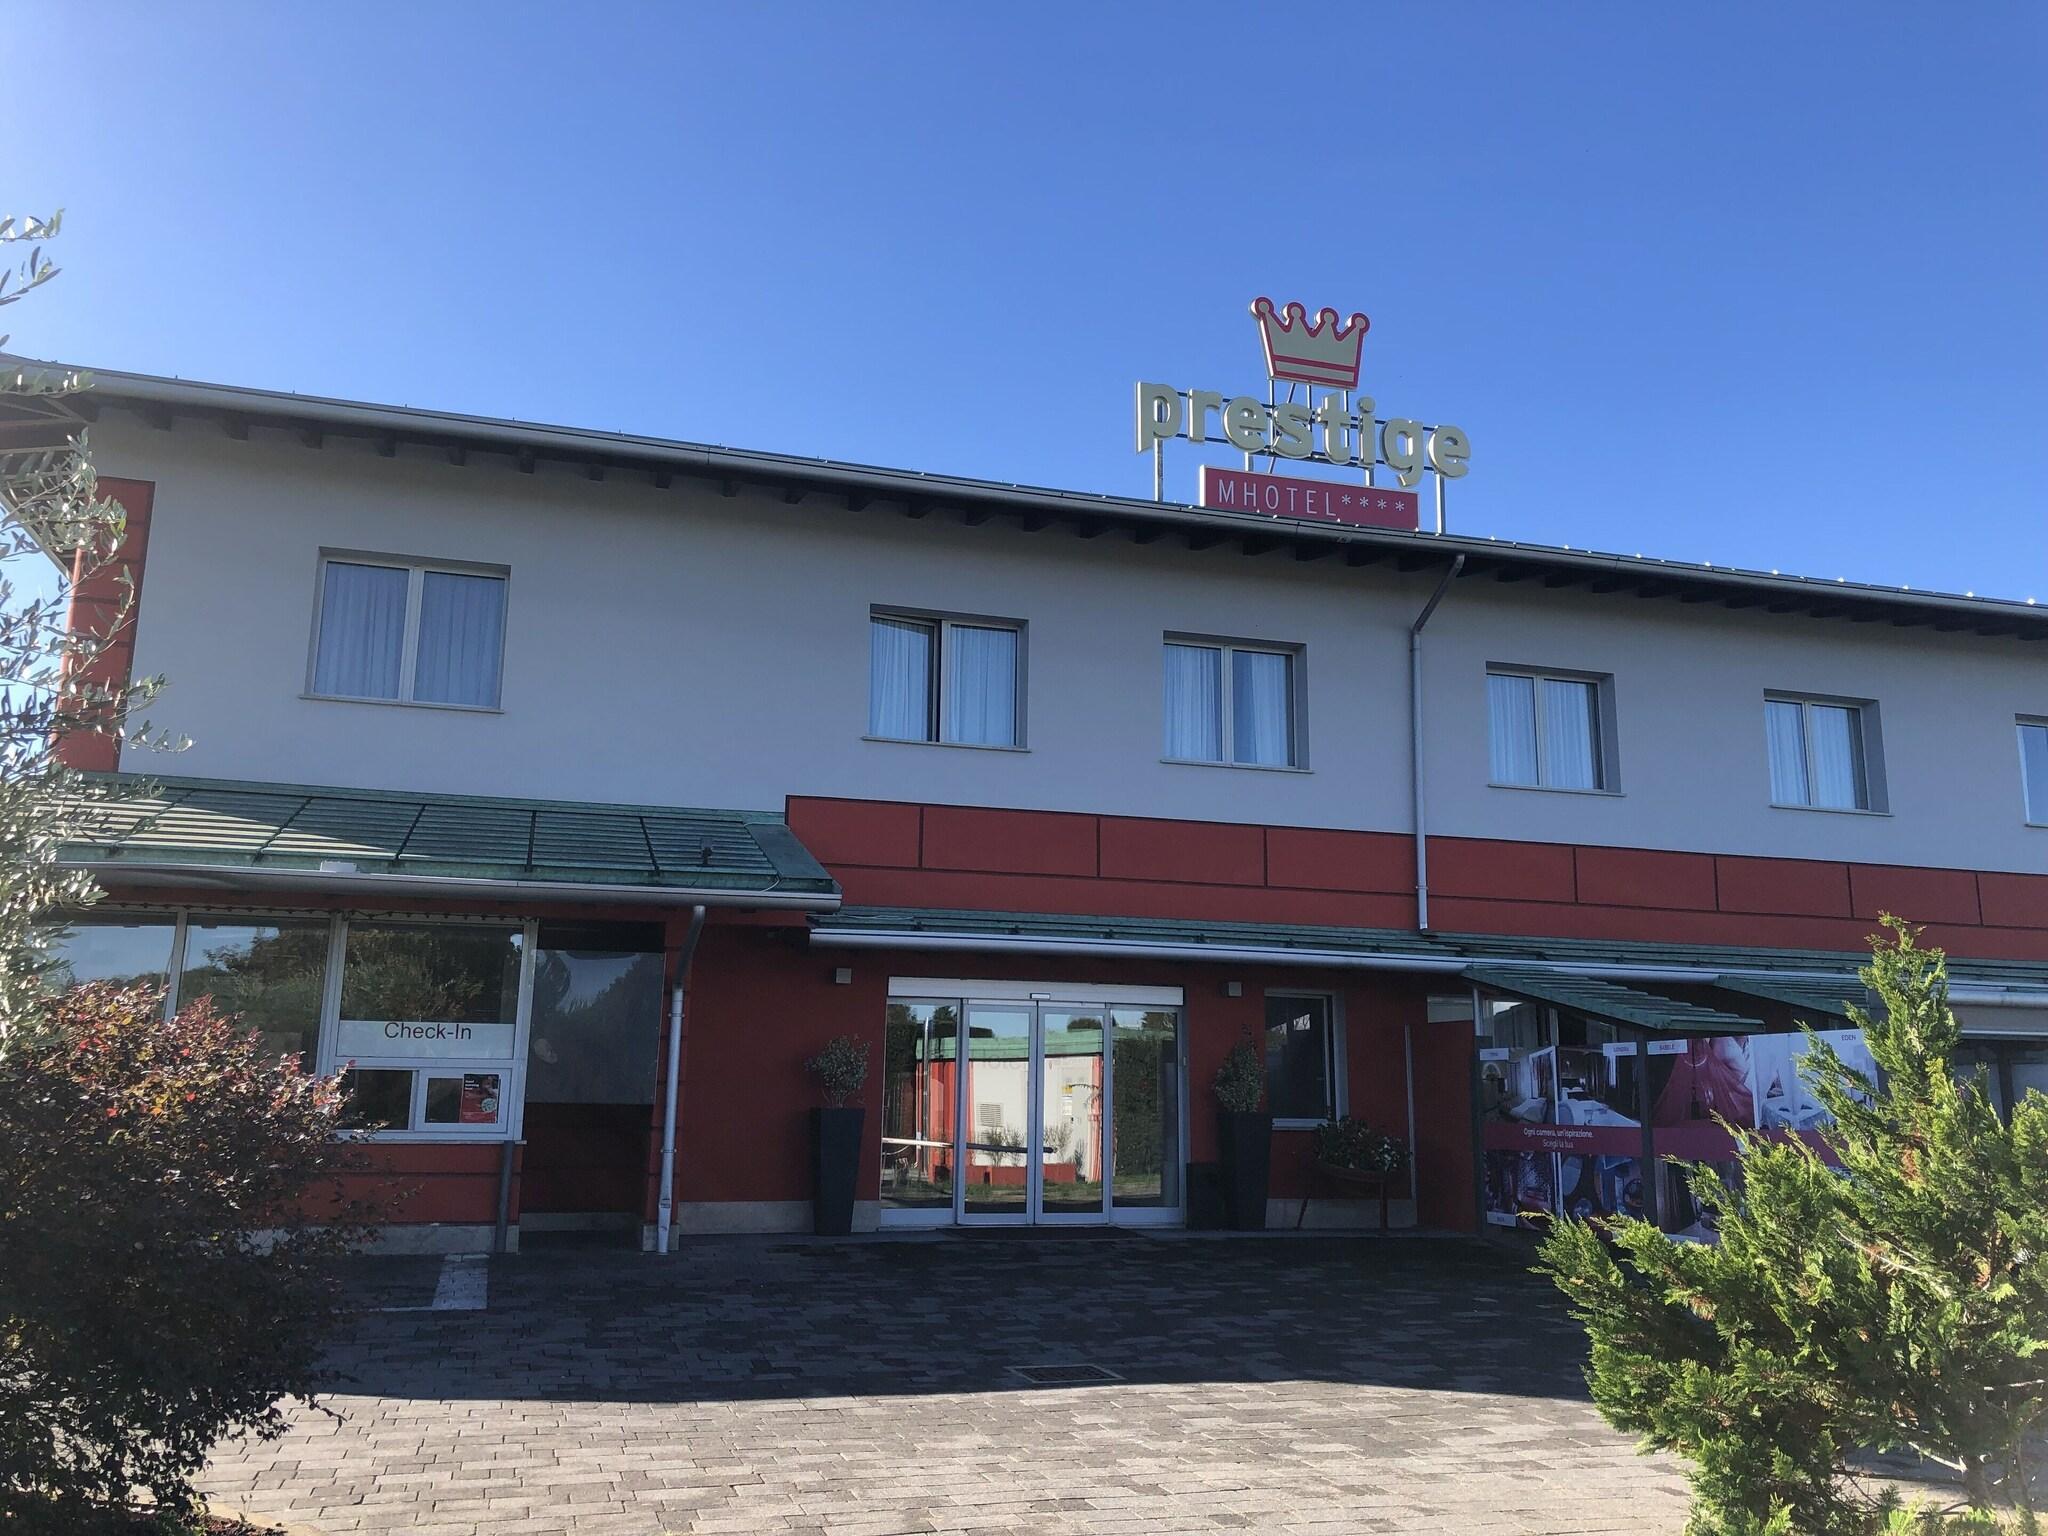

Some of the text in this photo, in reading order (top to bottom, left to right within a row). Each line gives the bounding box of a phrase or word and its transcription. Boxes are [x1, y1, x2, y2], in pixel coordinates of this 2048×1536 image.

[1136, 381, 1471, 487] prestige
[384, 1021, 471, 1040] Check-In
[1523, 1128, 1536, 1138] Ogni
